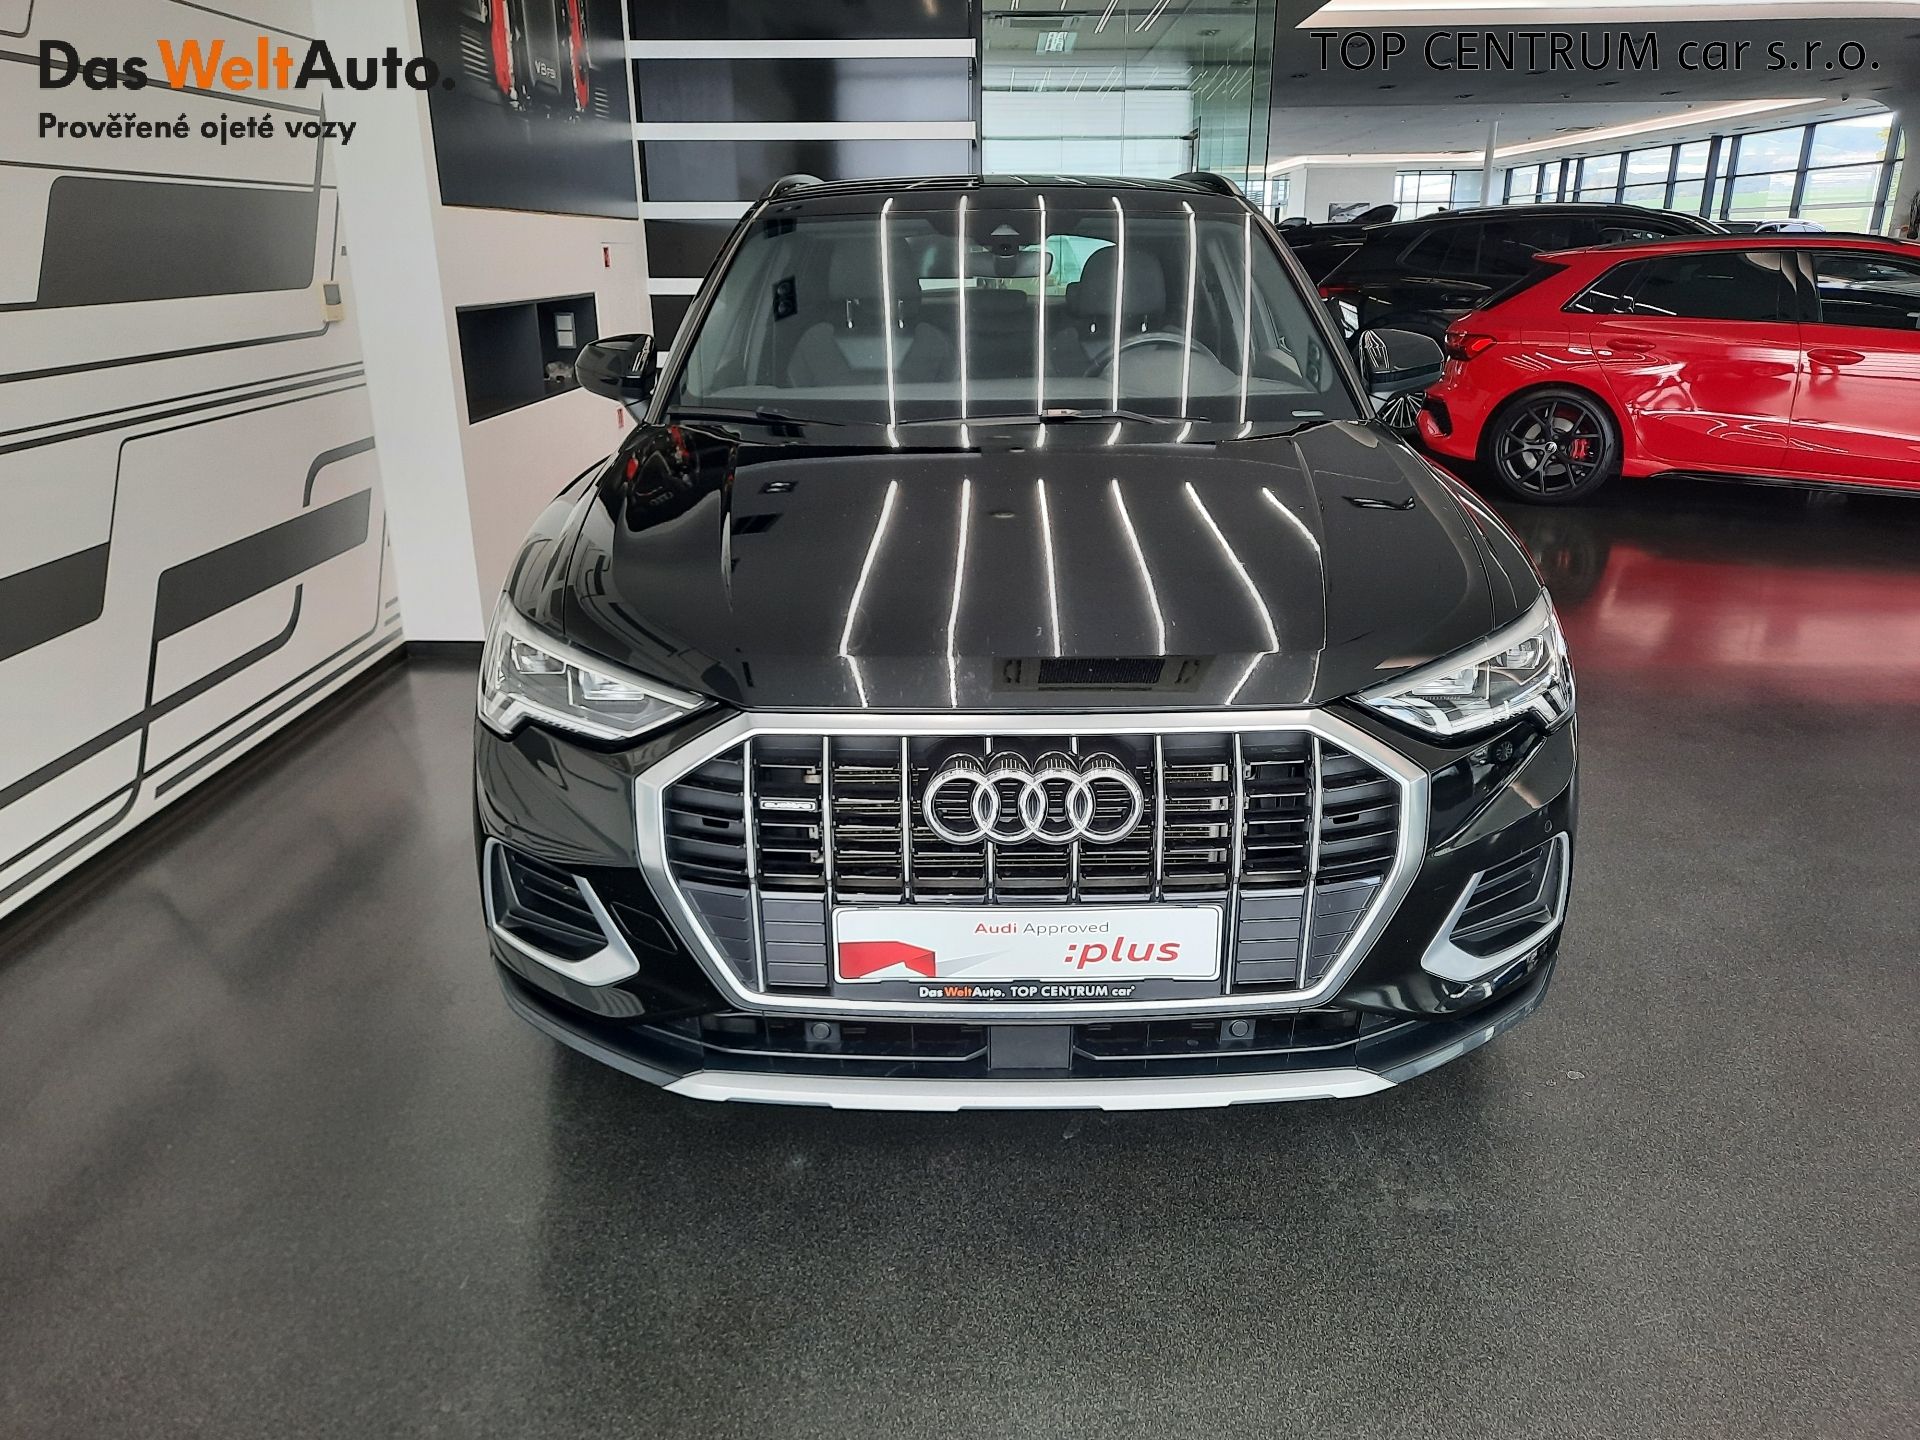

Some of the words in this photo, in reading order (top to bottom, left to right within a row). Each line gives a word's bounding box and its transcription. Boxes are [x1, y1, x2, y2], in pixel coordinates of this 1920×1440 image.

[974, 923, 1017, 934] Audi
[1023, 922, 1109, 936] Approved
[919, 986, 943, 998] Das
[1010, 985, 1038, 997] TOP
[1040, 985, 1109, 997] CENTRUM
